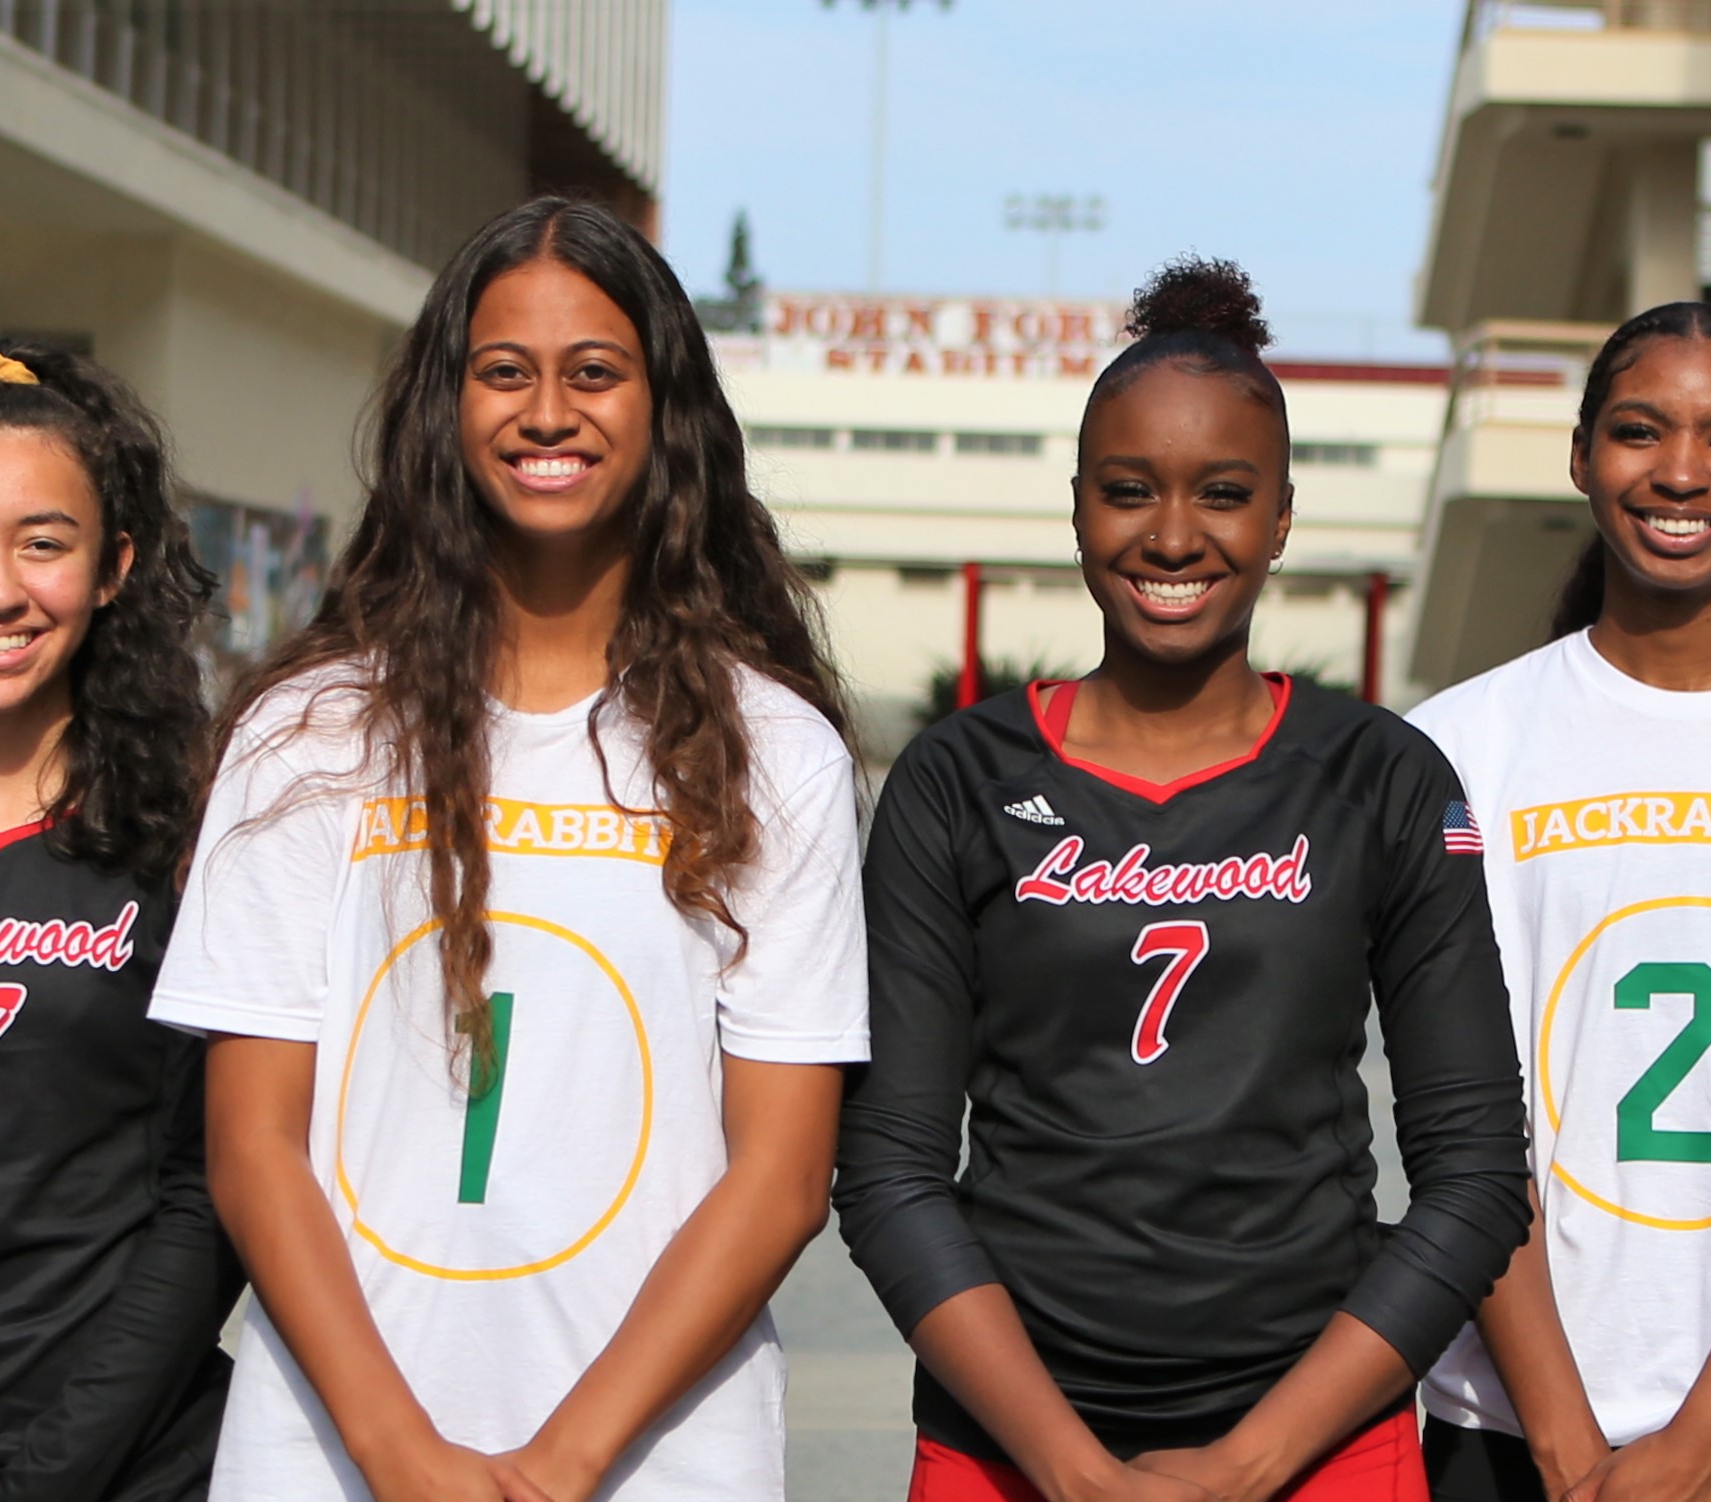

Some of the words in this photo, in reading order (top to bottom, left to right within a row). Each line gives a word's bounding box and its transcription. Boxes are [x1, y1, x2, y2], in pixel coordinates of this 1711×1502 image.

[775, 302, 934, 339] JOHN
[971, 306, 1134, 343] FOR
[825, 347, 1095, 377] STADIUM
[1003, 805, 1066, 826] adidas
[1015, 833, 1312, 906] Lakewood
[1130, 920, 1210, 1065] 7
[455, 991, 515, 1205] 1
